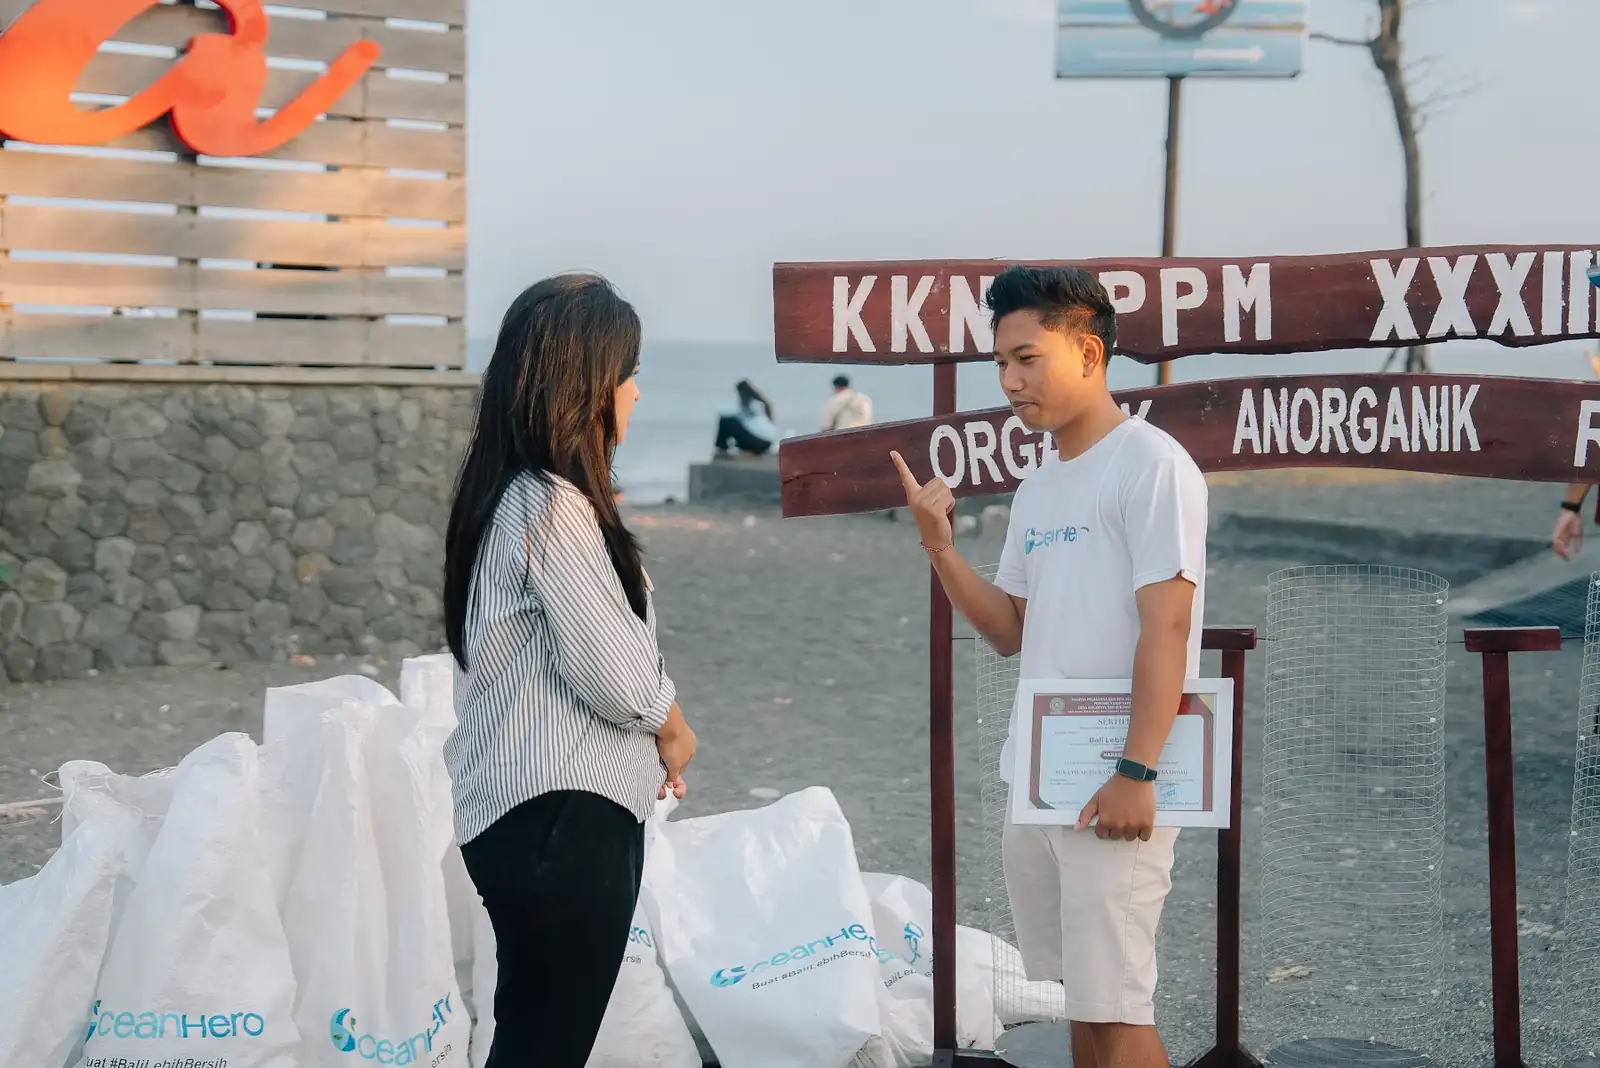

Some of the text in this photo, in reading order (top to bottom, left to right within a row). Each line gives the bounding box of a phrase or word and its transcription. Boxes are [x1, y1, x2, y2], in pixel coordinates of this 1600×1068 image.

[832, 274, 995, 353] KKN
[1232, 384, 1481, 455] ANORGANIK
[752, 976, 779, 990] Buat
[86, 1057, 108, 1068] uat
